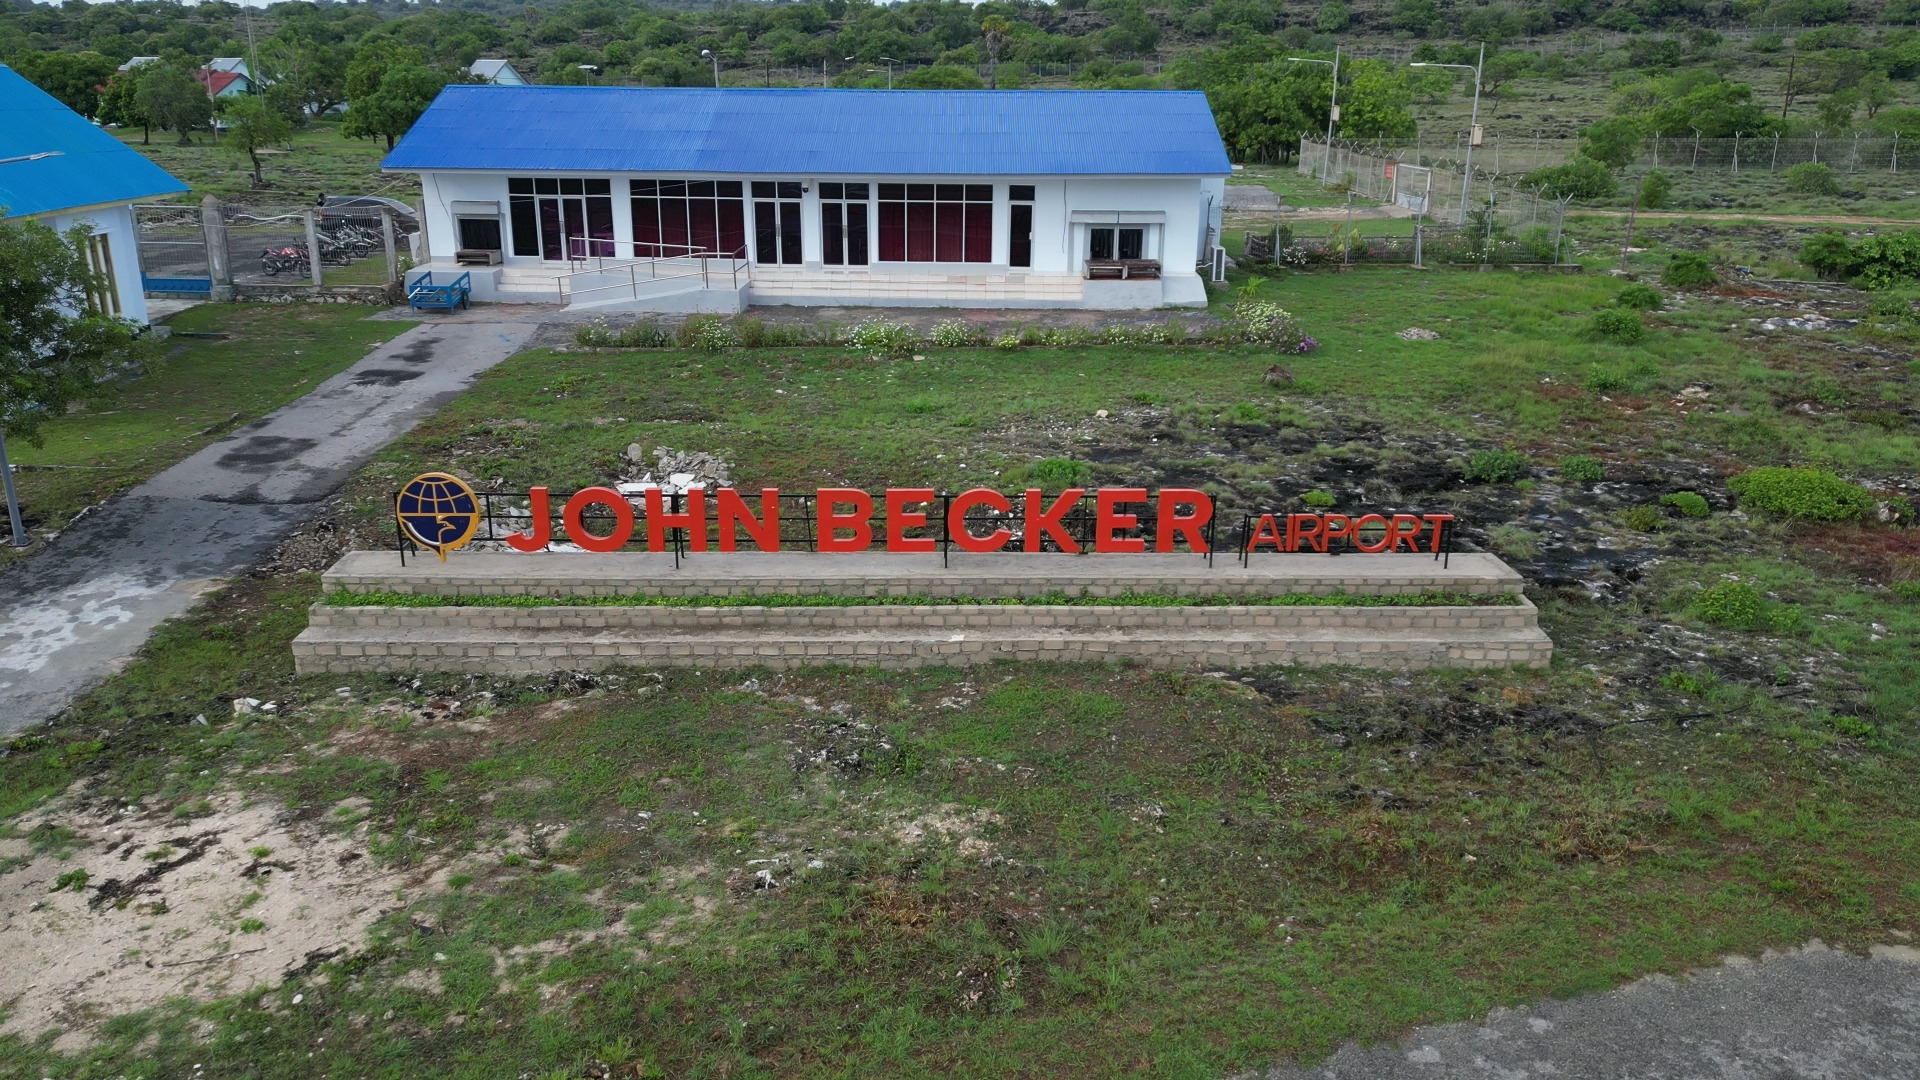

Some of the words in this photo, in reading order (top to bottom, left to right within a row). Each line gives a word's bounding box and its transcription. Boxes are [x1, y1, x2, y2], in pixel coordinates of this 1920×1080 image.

[505, 487, 780, 553] JOHN
[816, 487, 1213, 553] BECKER
[1246, 513, 1455, 553] AIRPORT
